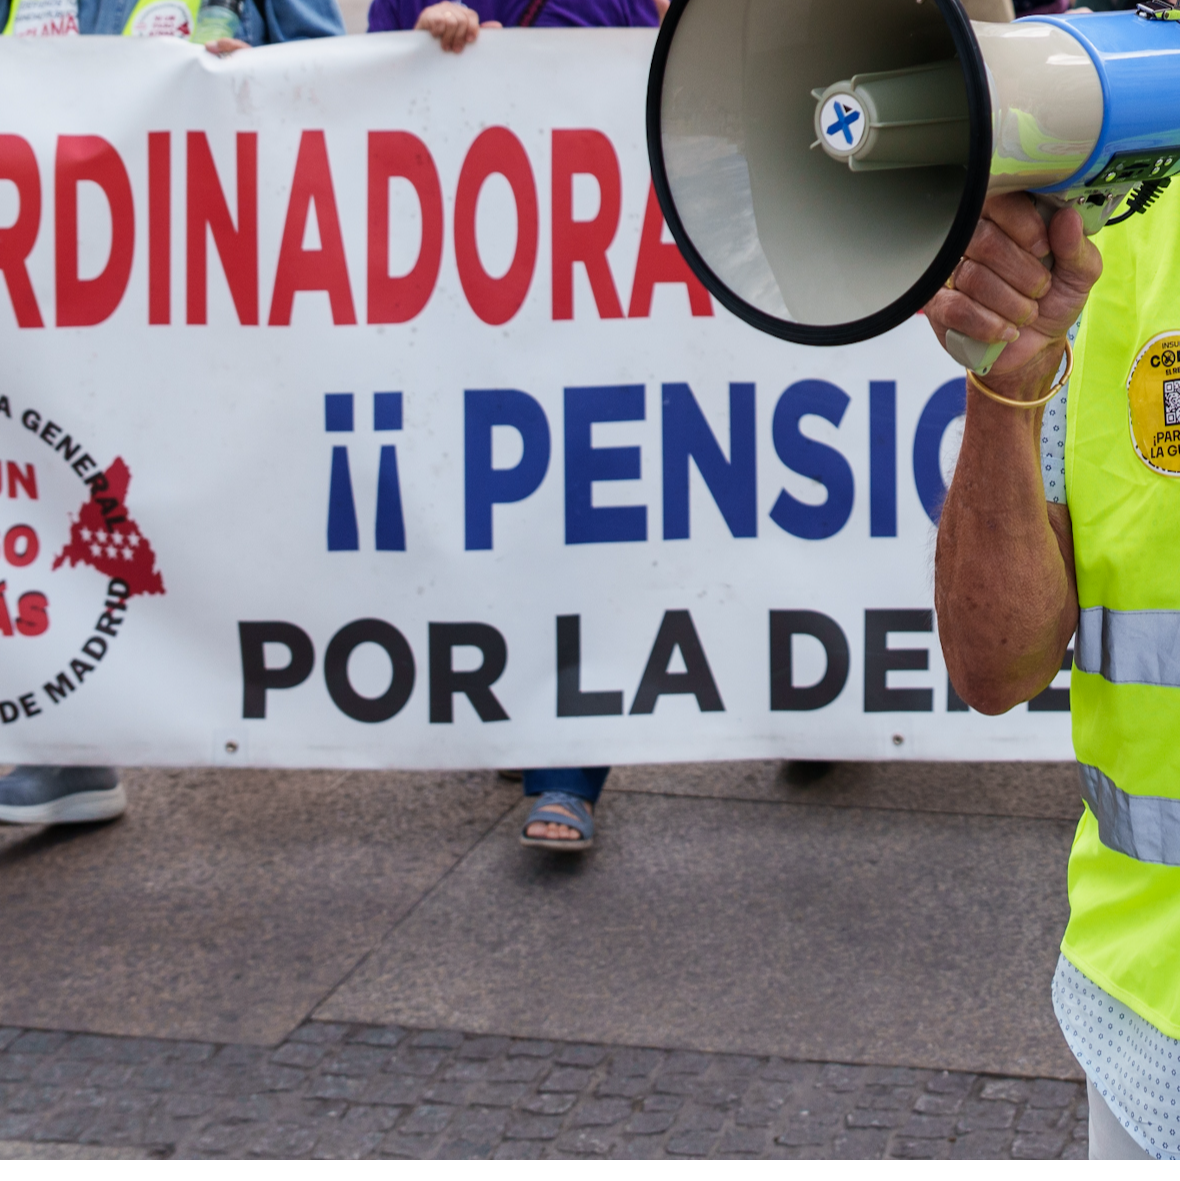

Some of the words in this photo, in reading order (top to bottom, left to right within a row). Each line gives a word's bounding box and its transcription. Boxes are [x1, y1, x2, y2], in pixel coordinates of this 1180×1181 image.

[21, 409, 127, 534] GENERAL
[1150, 446, 1164, 458] LA
[43, 577, 131, 705] MADRID
[238, 617, 511, 725] POR
[554, 608, 726, 718] LA
[767, 608, 1072, 714] DE
